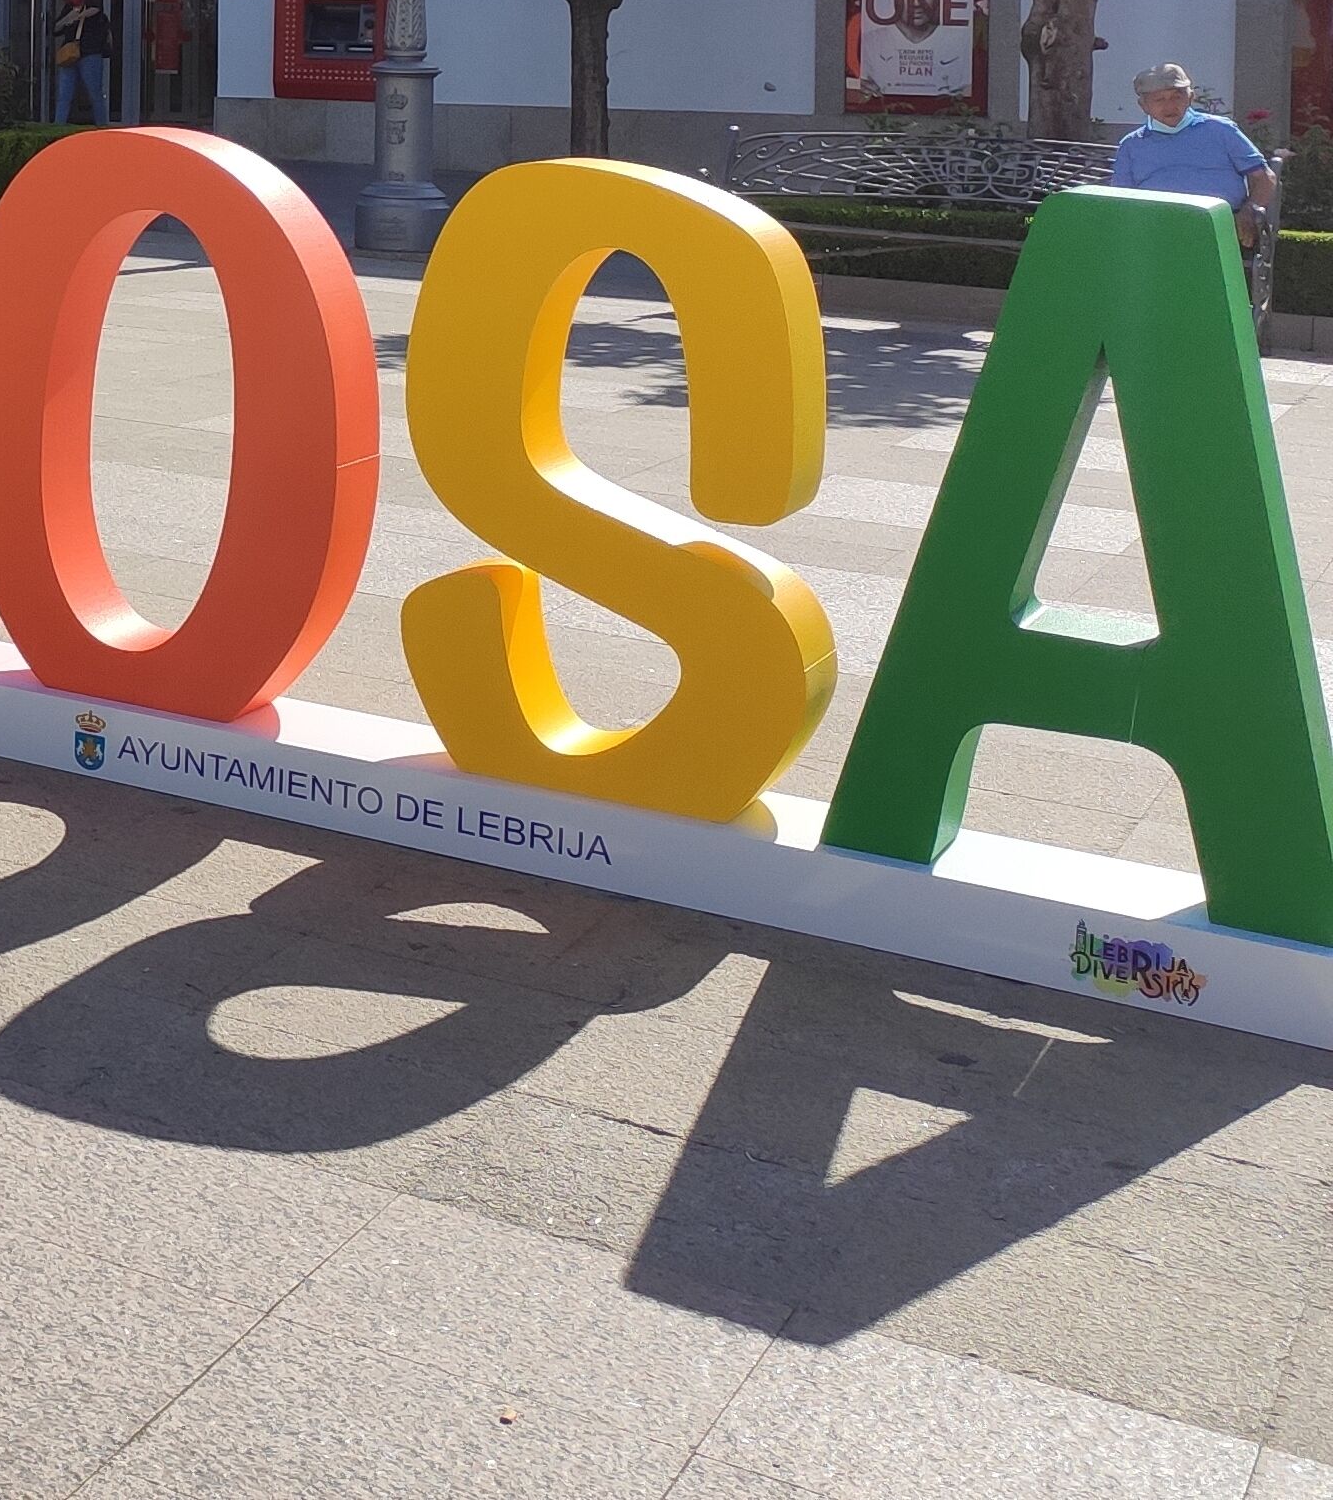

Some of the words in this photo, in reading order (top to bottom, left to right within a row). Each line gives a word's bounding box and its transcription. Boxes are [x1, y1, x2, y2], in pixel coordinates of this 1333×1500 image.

[899, 66, 933, 77] PLAN
[117, 735, 384, 815] AYUNTAMIENTO
[396, 793, 444, 831] DE
[457, 806, 613, 866] LEBRIJA
[1089, 933, 1190, 977] LEBRIJA
